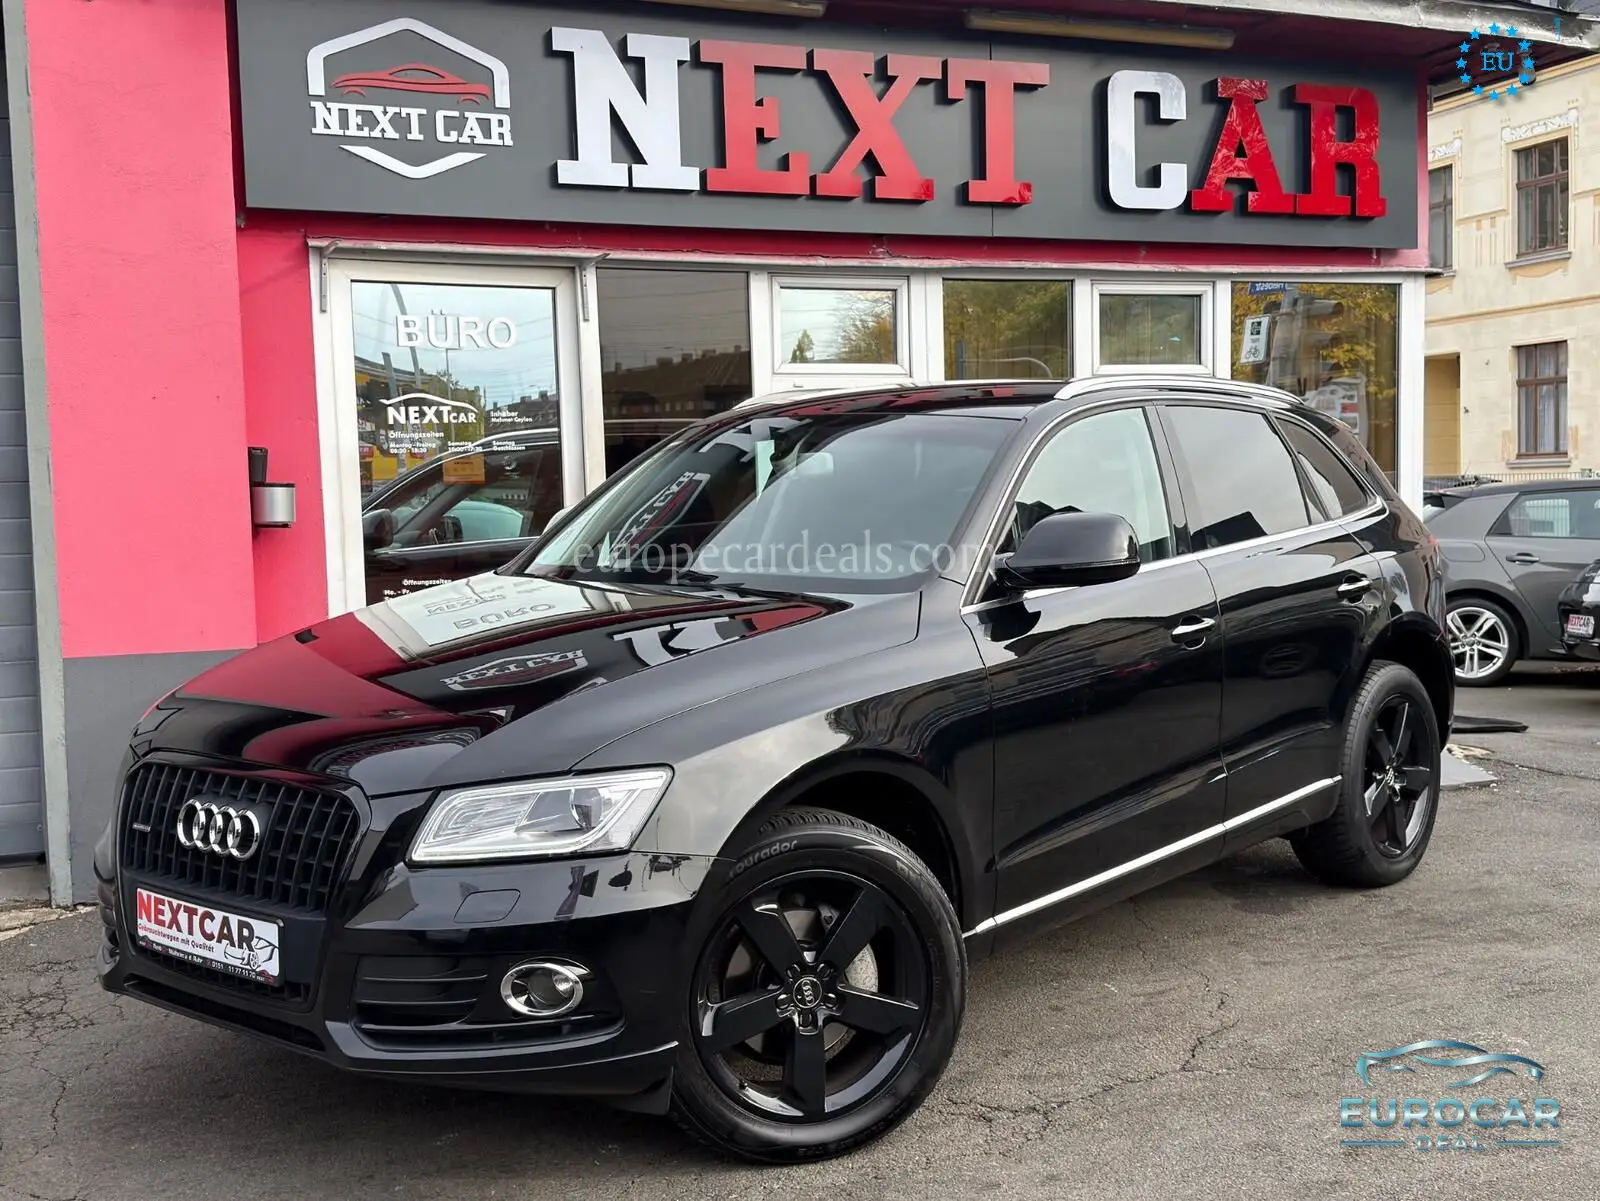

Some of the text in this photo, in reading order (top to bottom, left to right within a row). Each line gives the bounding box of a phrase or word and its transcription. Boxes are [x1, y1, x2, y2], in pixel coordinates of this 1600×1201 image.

[310, 100, 513, 146] NEXT CAR
[551, 27, 1387, 218] NEXT CAR
[396, 309, 517, 350] BÜRO
[137, 891, 255, 953] NEXTCAR
